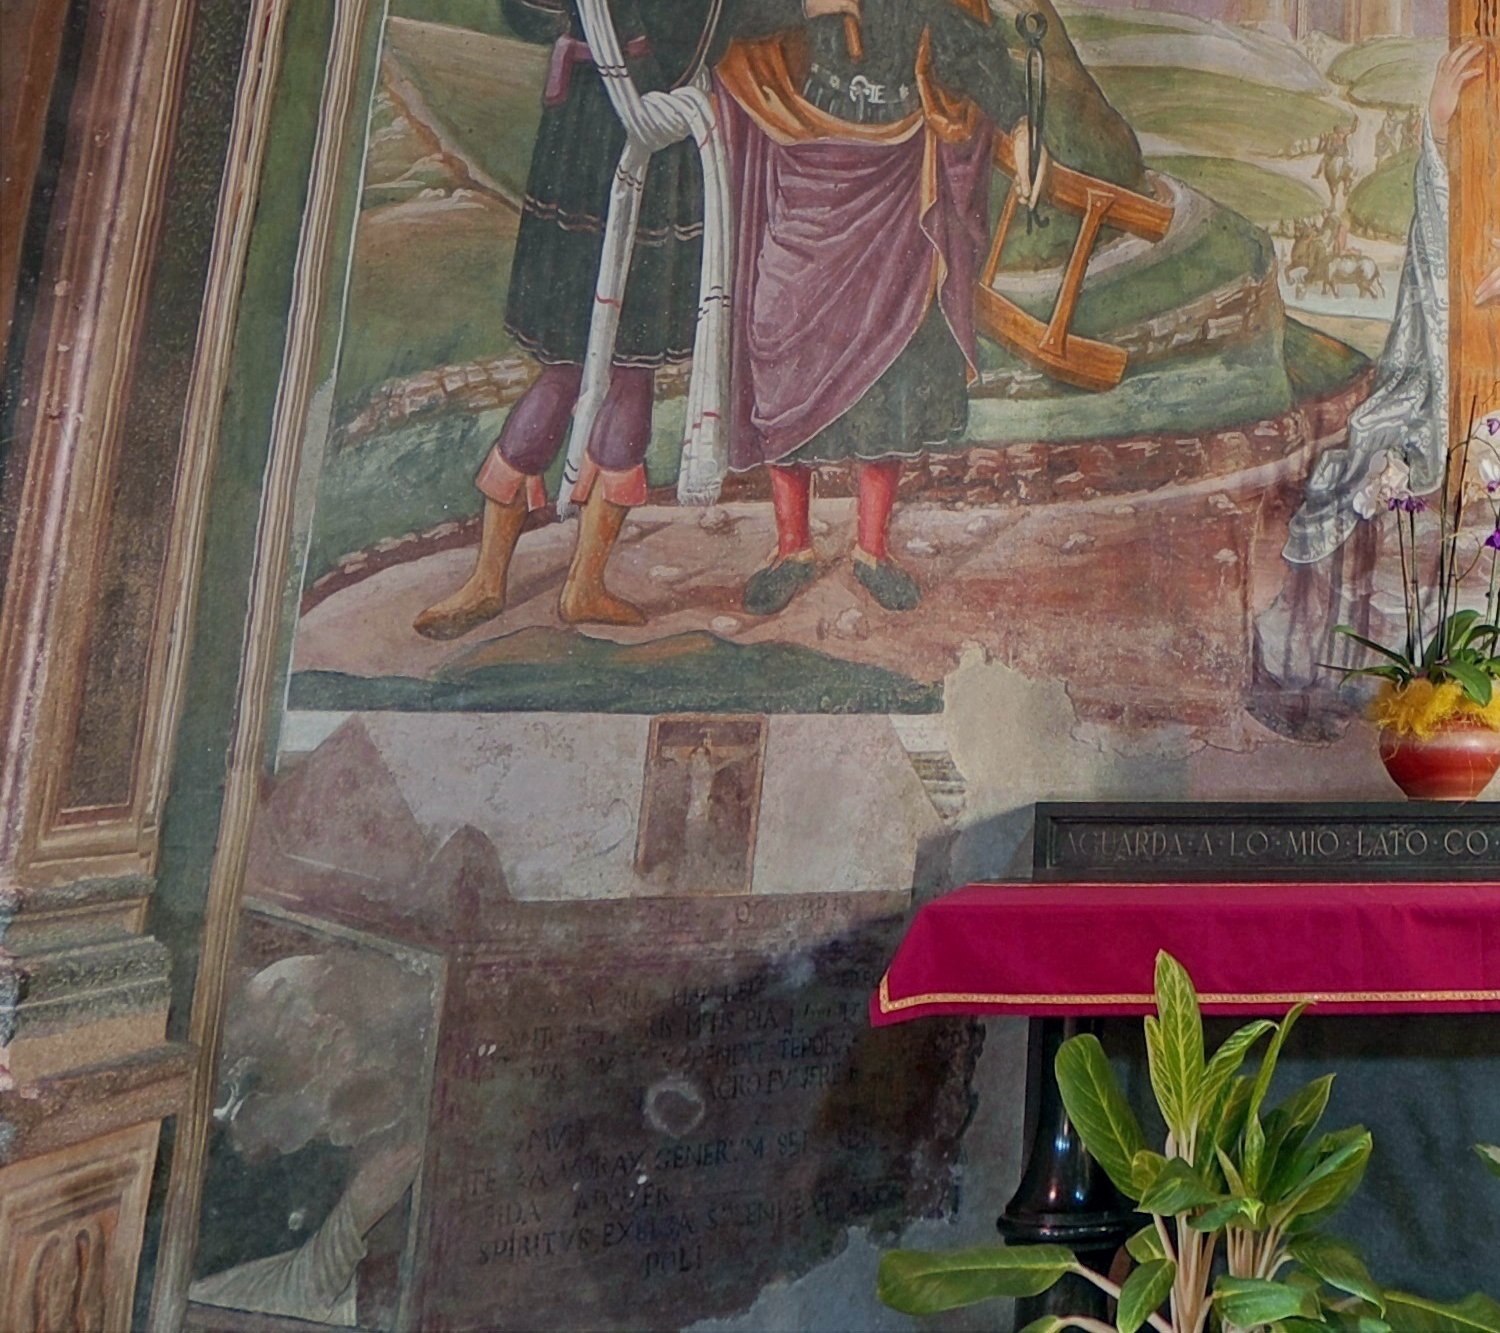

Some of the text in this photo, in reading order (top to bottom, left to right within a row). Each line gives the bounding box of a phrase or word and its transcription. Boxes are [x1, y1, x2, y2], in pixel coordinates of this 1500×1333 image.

[1064, 828, 1183, 857] AGUARDA
[1196, 828, 1216, 857] A
[1229, 828, 1270, 857] LO
[1286, 828, 1341, 856] MIO
[1356, 827, 1429, 856] LATO
[1442, 827, 1489, 855] CO
